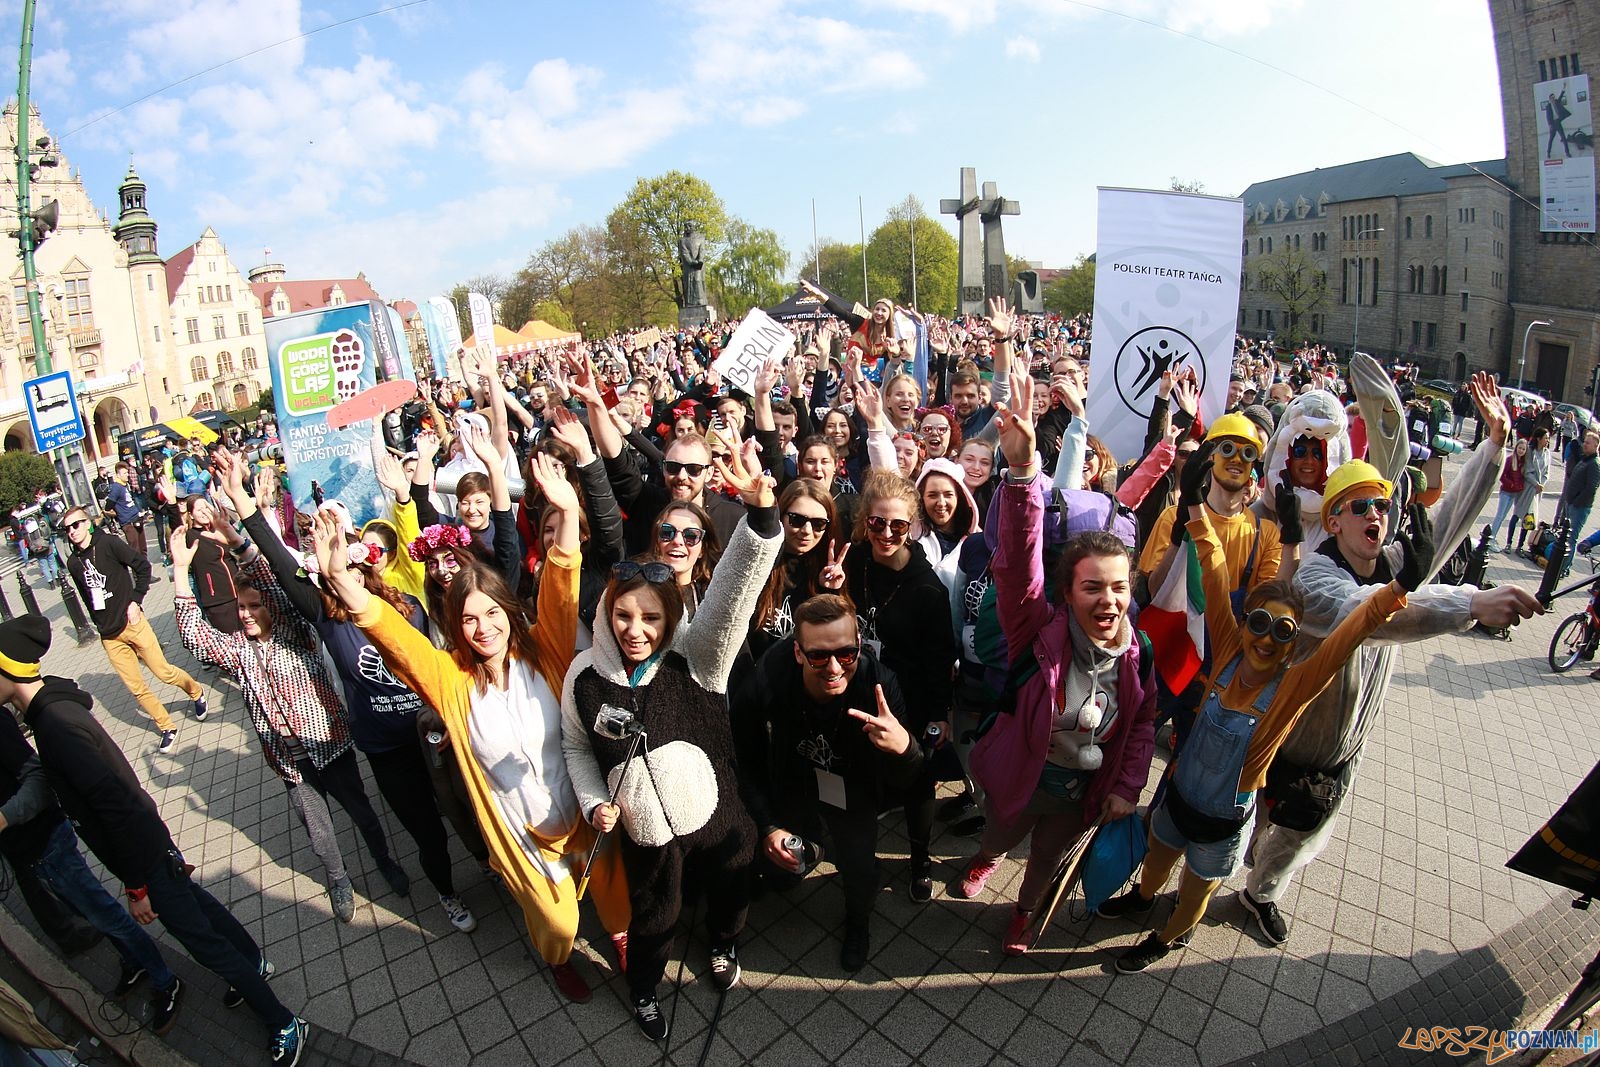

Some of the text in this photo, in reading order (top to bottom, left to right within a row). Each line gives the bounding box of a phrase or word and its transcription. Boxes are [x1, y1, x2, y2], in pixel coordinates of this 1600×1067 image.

[1562, 221, 1589, 229] Canon
[1113, 263, 1223, 284] POLSKI TEATR TAŃCA
[288, 346, 328, 363] WODA
[727, 316, 786, 387] BERLIN
[290, 360, 329, 379] GÓRY
[291, 374, 331, 395] LAS
[40, 422, 77, 439] Turystyczny
[46, 440, 56, 448] do
[292, 436, 325, 452] SKLEP
[293, 442, 364, 464] TURYSTYCZNY
